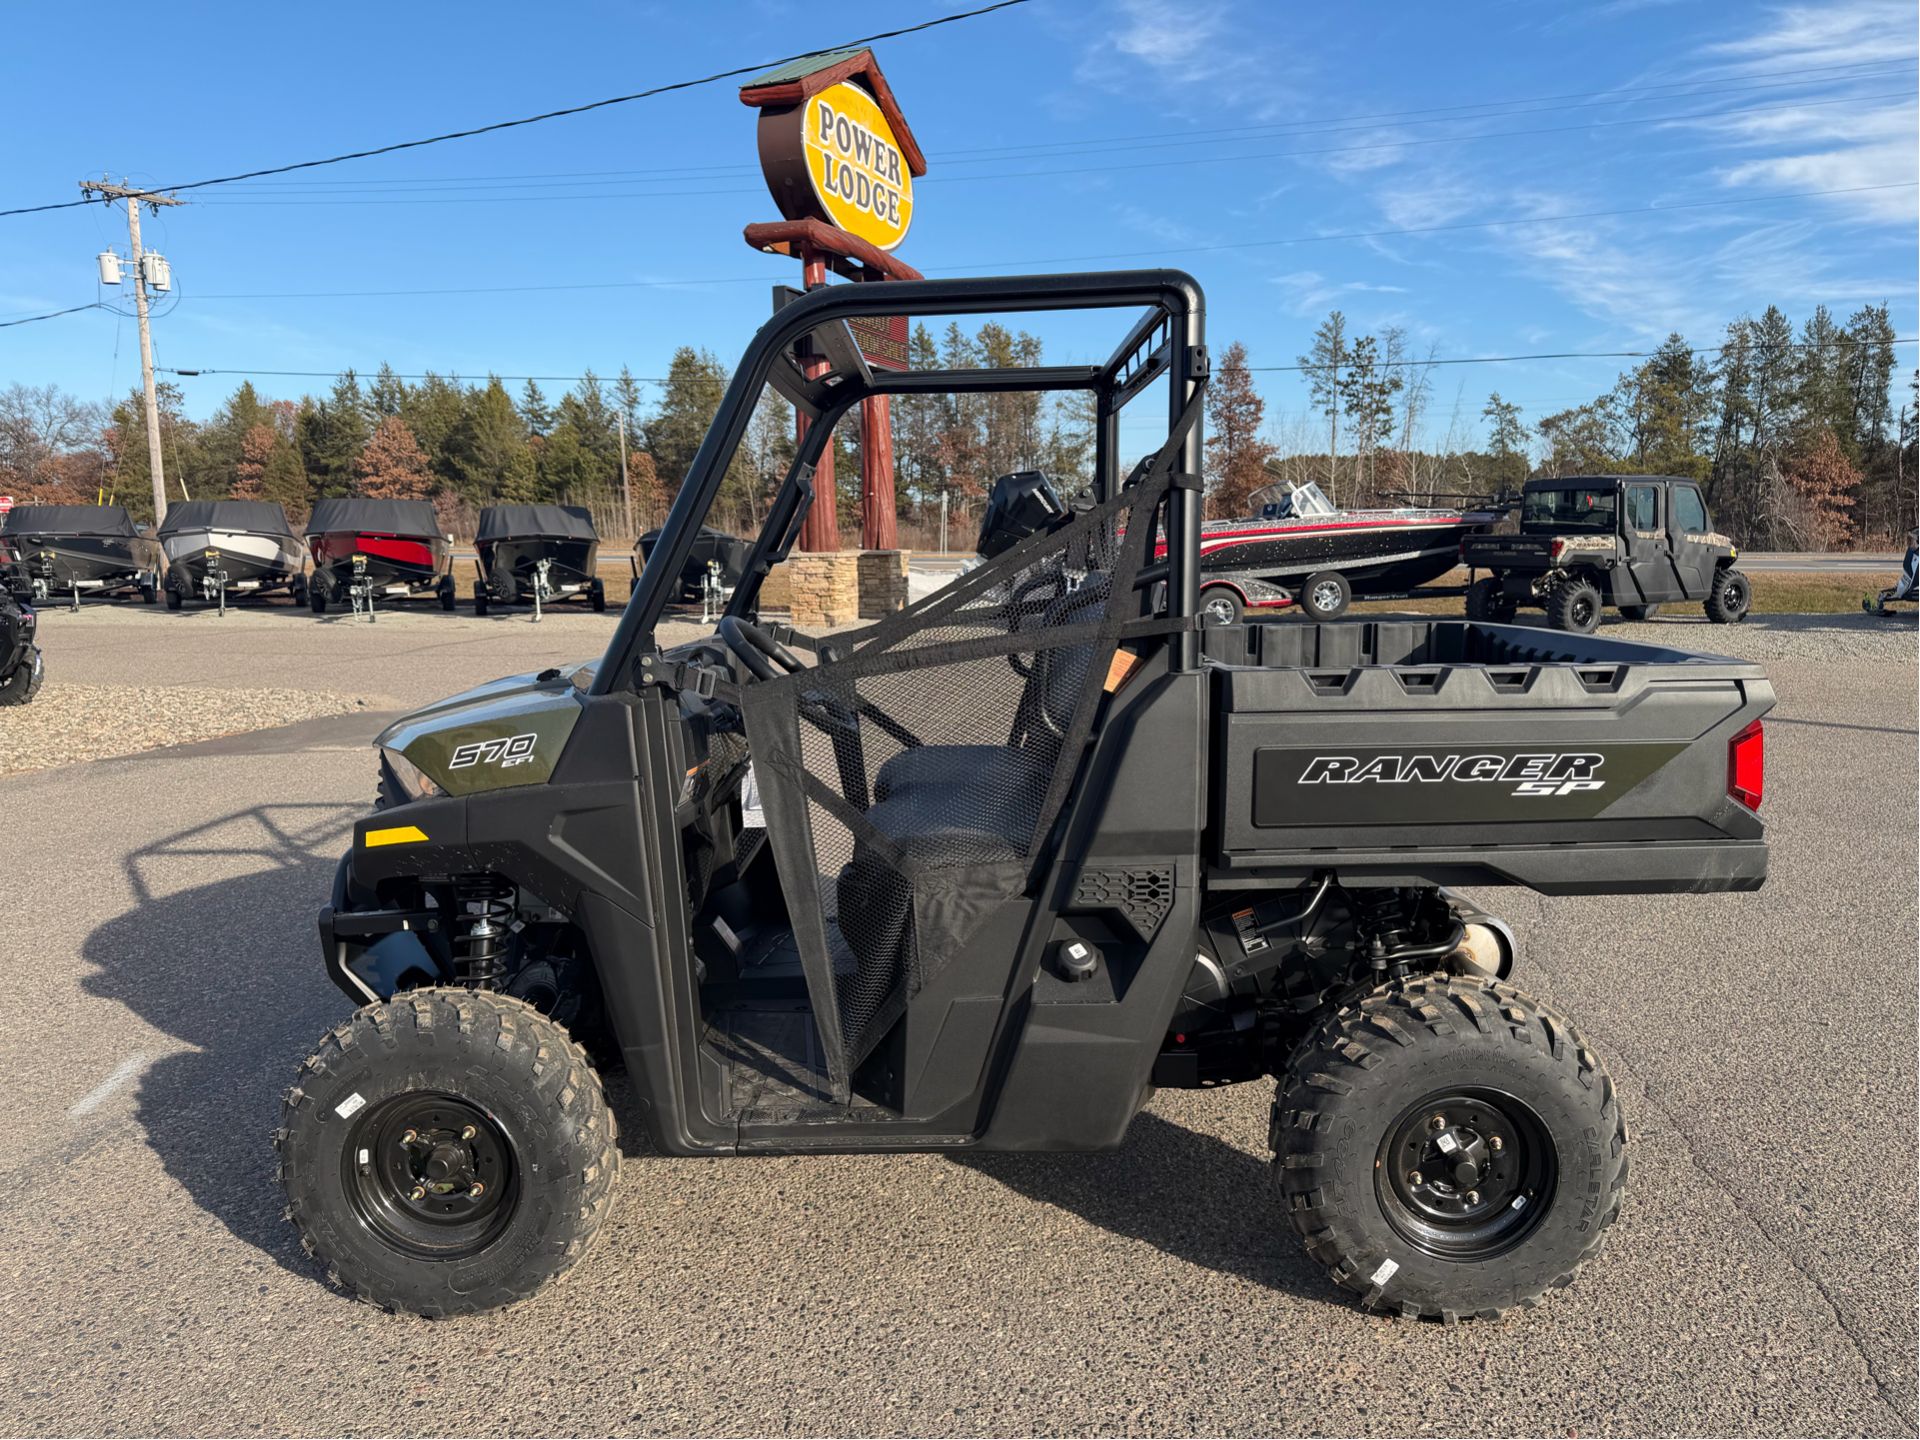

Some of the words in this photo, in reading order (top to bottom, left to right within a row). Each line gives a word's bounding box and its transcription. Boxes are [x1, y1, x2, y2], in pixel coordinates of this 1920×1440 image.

[819, 102, 902, 187] POWER
[822, 153, 900, 226] LODGE
[448, 733, 537, 769] 570
[501, 755, 535, 768] EFI
[1298, 753, 1604, 783] RANGER
[1511, 781, 1605, 796] SP
